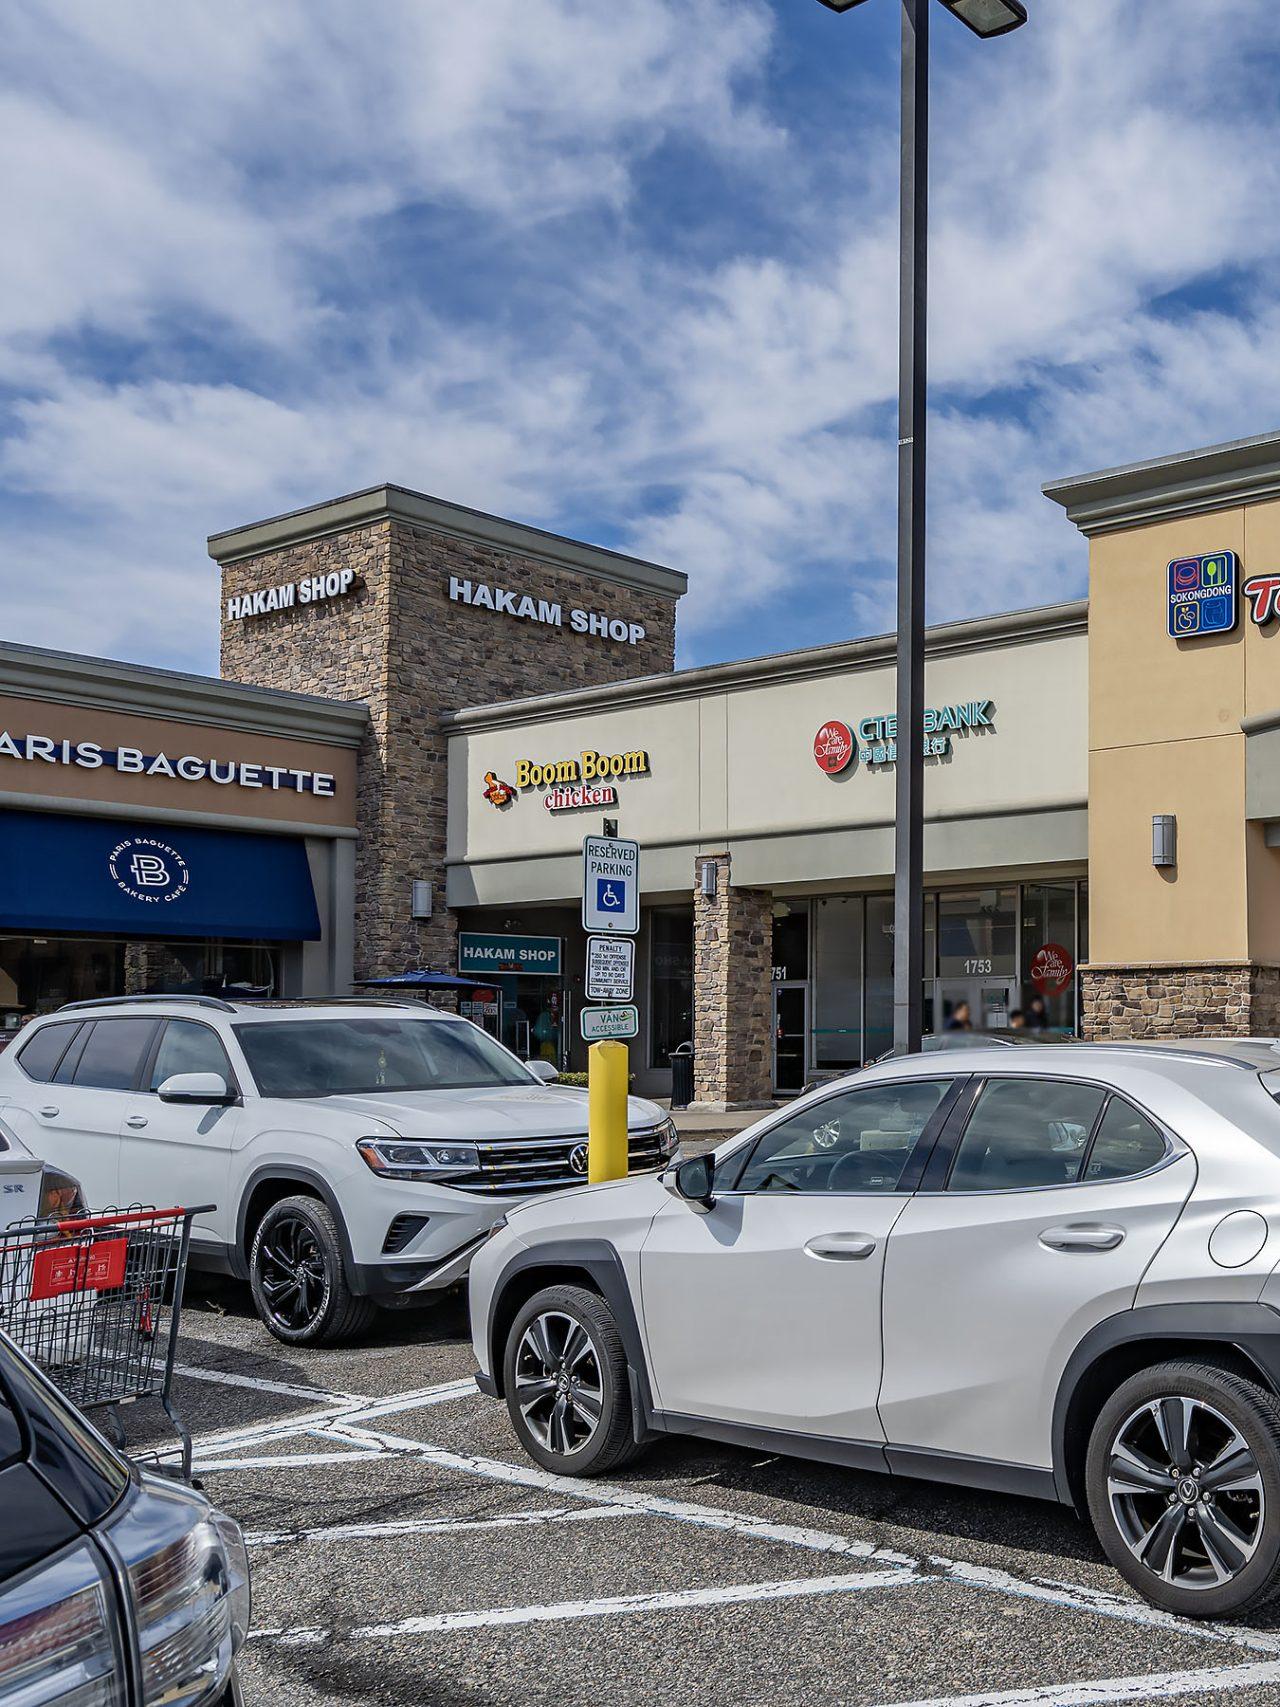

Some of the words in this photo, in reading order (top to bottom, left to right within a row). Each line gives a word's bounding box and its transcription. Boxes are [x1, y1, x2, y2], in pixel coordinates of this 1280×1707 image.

[227, 584, 296, 621] HAKAM
[298, 568, 355, 604] SHOP
[1170, 585, 1232, 604] SOKONGDONG
[449, 576, 562, 627] HAKAM
[569, 608, 646, 645] SHOP
[923, 700, 990, 732] BANK
[820, 728, 839, 739] We
[0, 730, 103, 768] ARIS
[116, 746, 335, 797] BAGUETTE
[515, 759, 578, 787] Boom
[580, 750, 648, 779] Boom
[543, 786, 614, 810] chicken
[110, 840, 132, 861] PARIS
[134, 838, 186, 867] BAGUETTE
[588, 845, 635, 861] RESERVED
[591, 861, 632, 876] PARKING
[118, 882, 160, 902] BAKERY
[463, 946, 515, 959] HAKAM
[519, 949, 556, 961] SHOP
[599, 944, 623, 953] PENALTY
[771, 966, 786, 980] 751
[964, 959, 992, 974] 1753
[600, 1014, 620, 1023] VAN
[592, 1024, 629, 1033] ACCESSIBLE
[3, 1184, 25, 1194] SR
